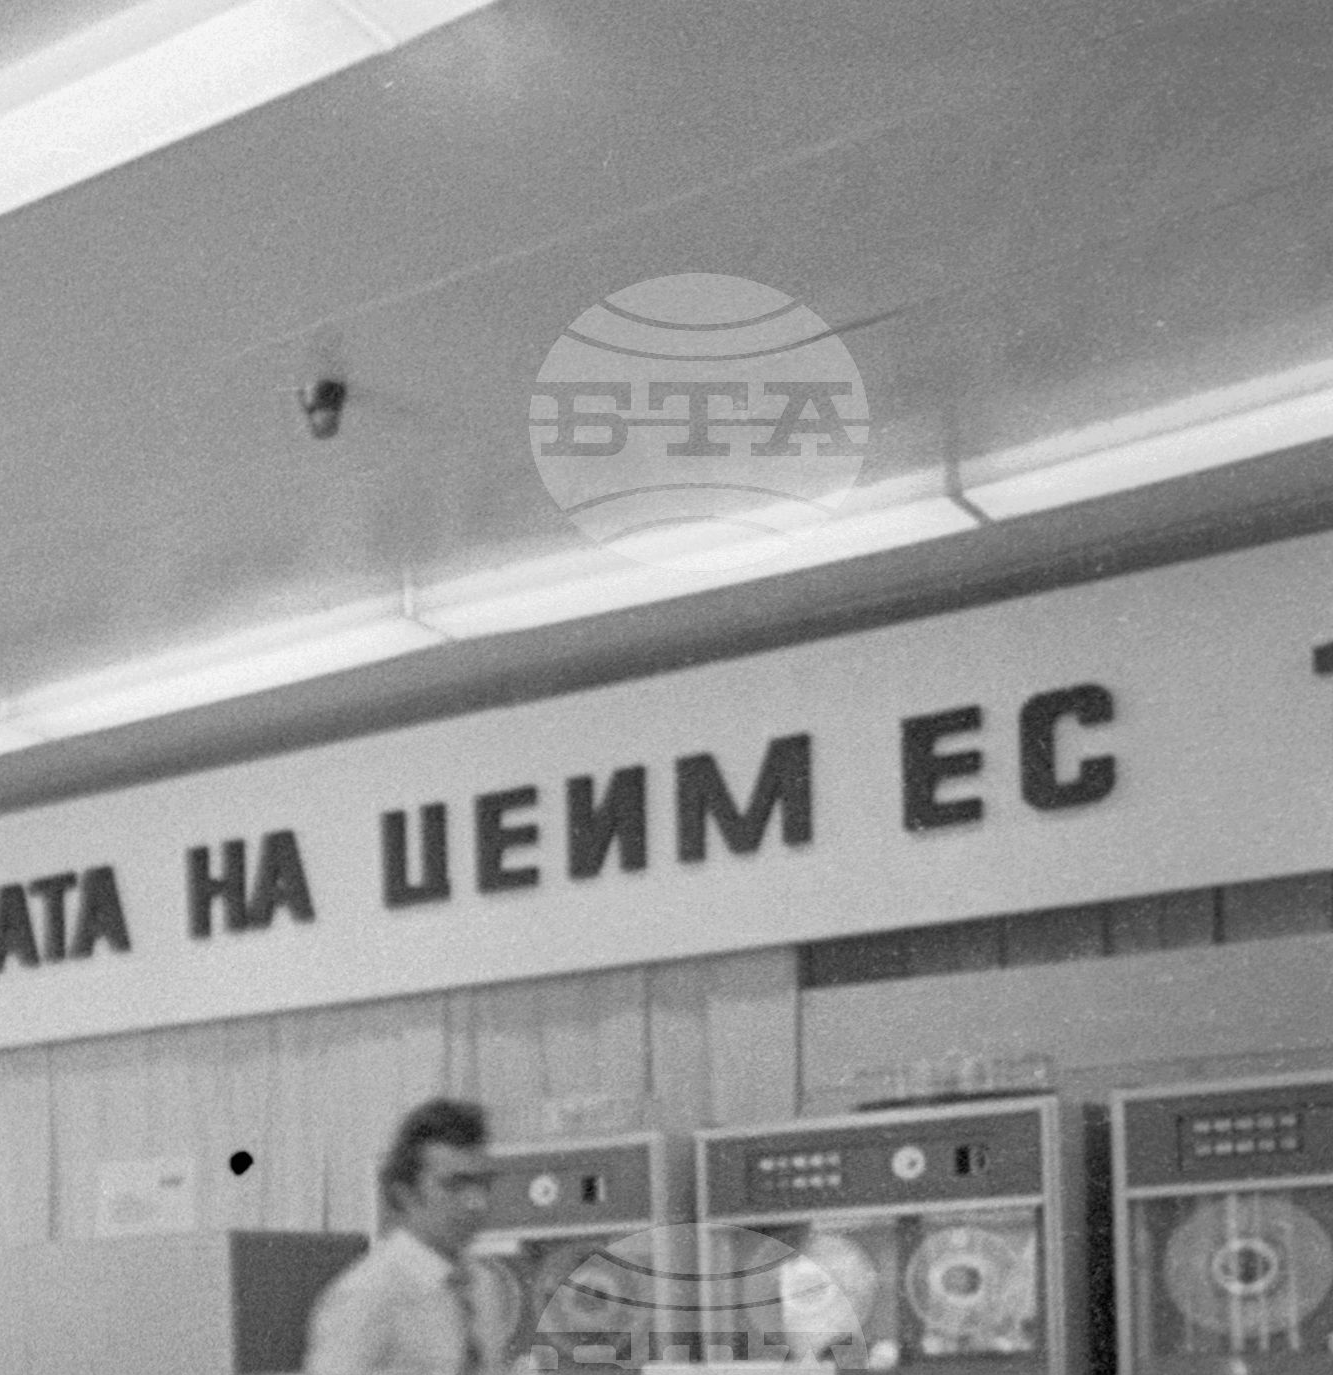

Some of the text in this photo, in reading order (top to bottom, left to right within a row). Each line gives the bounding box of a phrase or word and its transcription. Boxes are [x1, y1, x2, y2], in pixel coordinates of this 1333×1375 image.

[187, 830, 315, 939] НА
[382, 732, 814, 909] ЦЕИМ
[900, 683, 1118, 833] ЕС
